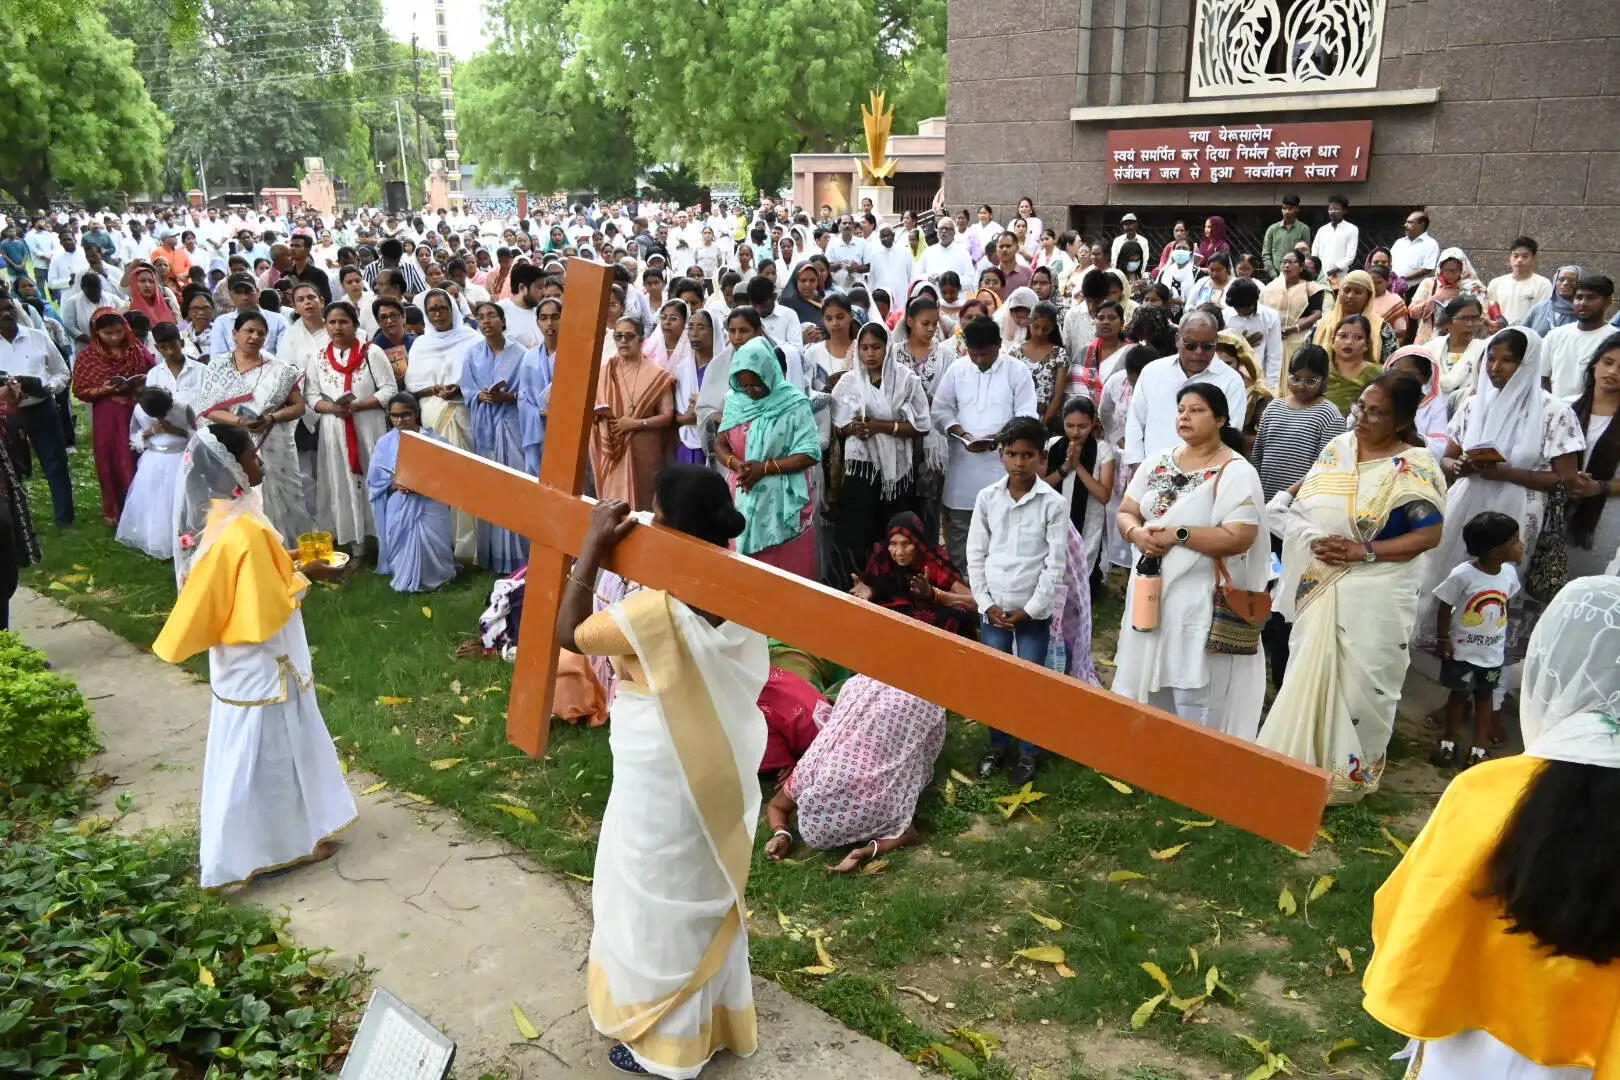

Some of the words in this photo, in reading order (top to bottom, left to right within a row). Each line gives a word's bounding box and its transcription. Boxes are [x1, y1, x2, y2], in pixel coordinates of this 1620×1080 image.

[1189, 130, 1211, 142] नया
[1113, 148, 1136, 162] स्वयं
[1140, 145, 1176, 162] समर्पित
[1181, 148, 1200, 160] कर
[1206, 145, 1231, 162] दिया
[1236, 143, 1269, 160] निर्मल
[1317, 144, 1341, 158] धार
[1113, 165, 1150, 180] संजीवन
[1159, 167, 1180, 179] जल
[1189, 163, 1201, 179] से
[1210, 166, 1234, 182] हुआ
[1243, 162, 1294, 179] नवजीवन
[1304, 162, 1338, 178] संचार
